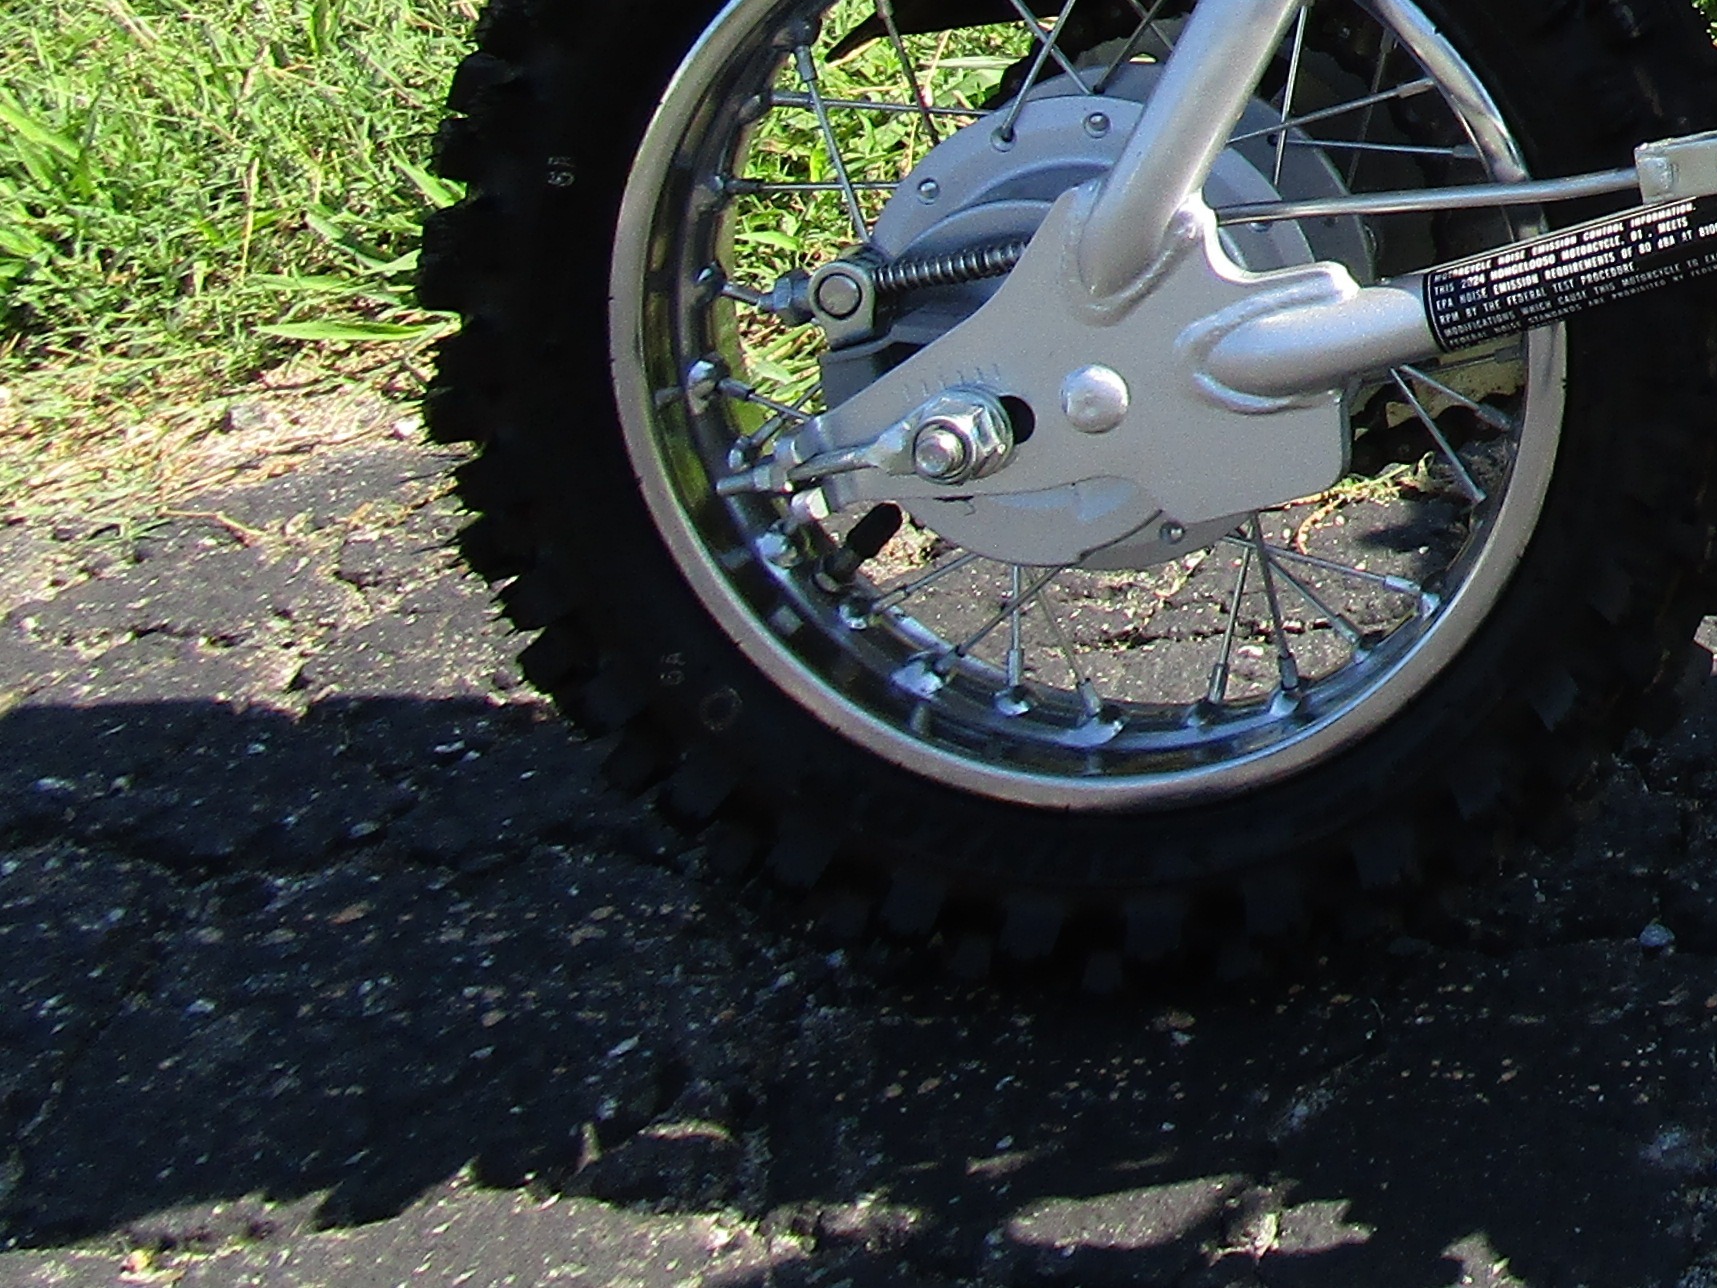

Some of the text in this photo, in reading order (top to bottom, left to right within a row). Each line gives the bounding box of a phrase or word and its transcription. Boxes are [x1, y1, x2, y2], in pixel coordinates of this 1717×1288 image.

[1434, 202, 1696, 282] MOTORCYCLE NOISE EMISSION CONTROL INFORMATION.
[1434, 284, 1454, 296] THIS
[1461, 273, 1486, 289] 2024
[1657, 216, 1689, 234] MEETS
[1436, 298, 1454, 311] EPA
[1459, 288, 1488, 304] NOISE
[1493, 273, 1539, 296] EMISSION
[1544, 252, 1616, 281] REQUIREMENTS
[1620, 246, 1633, 259] OF
[1681, 230, 1693, 241] AT
[1439, 312, 1460, 325] RPM
[1465, 306, 1477, 318] BY
[1482, 299, 1501, 313] THE
[1506, 287, 1547, 306] FEDERAL
[1552, 279, 1575, 293] TEST
[1443, 310, 1516, 338] MODIFICATIONS
[1520, 300, 1552, 316] WHICH
[1557, 290, 1588, 306] CAUSE
[1593, 281, 1616, 295] THIS
[1621, 263, 1681, 288] MOTORCYCLE
[1686, 258, 1699, 268] TO
